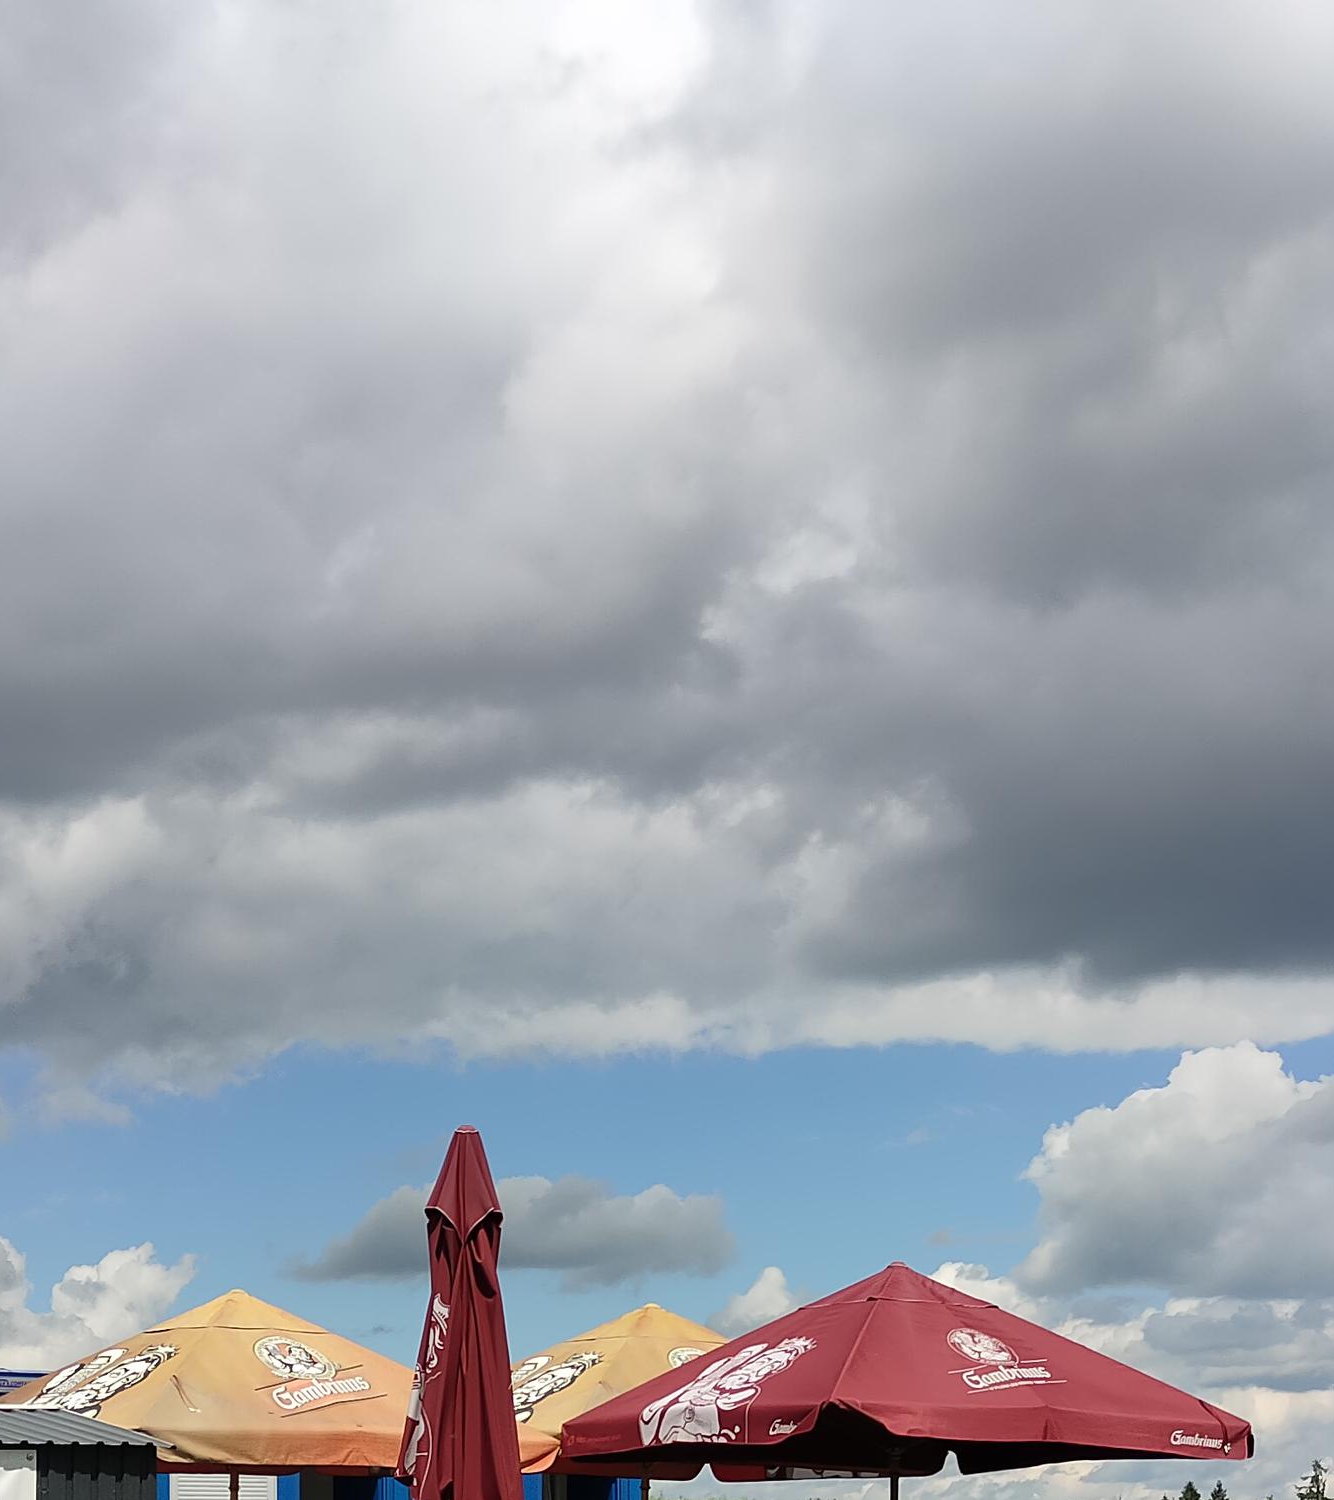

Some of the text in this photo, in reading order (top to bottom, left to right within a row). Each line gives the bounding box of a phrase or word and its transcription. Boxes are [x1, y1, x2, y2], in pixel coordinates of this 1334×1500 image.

[962, 1365, 1052, 1389] Gambrinus
[272, 1376, 371, 1410] Gambrinus
[1170, 1430, 1223, 1449] Gambrinus
